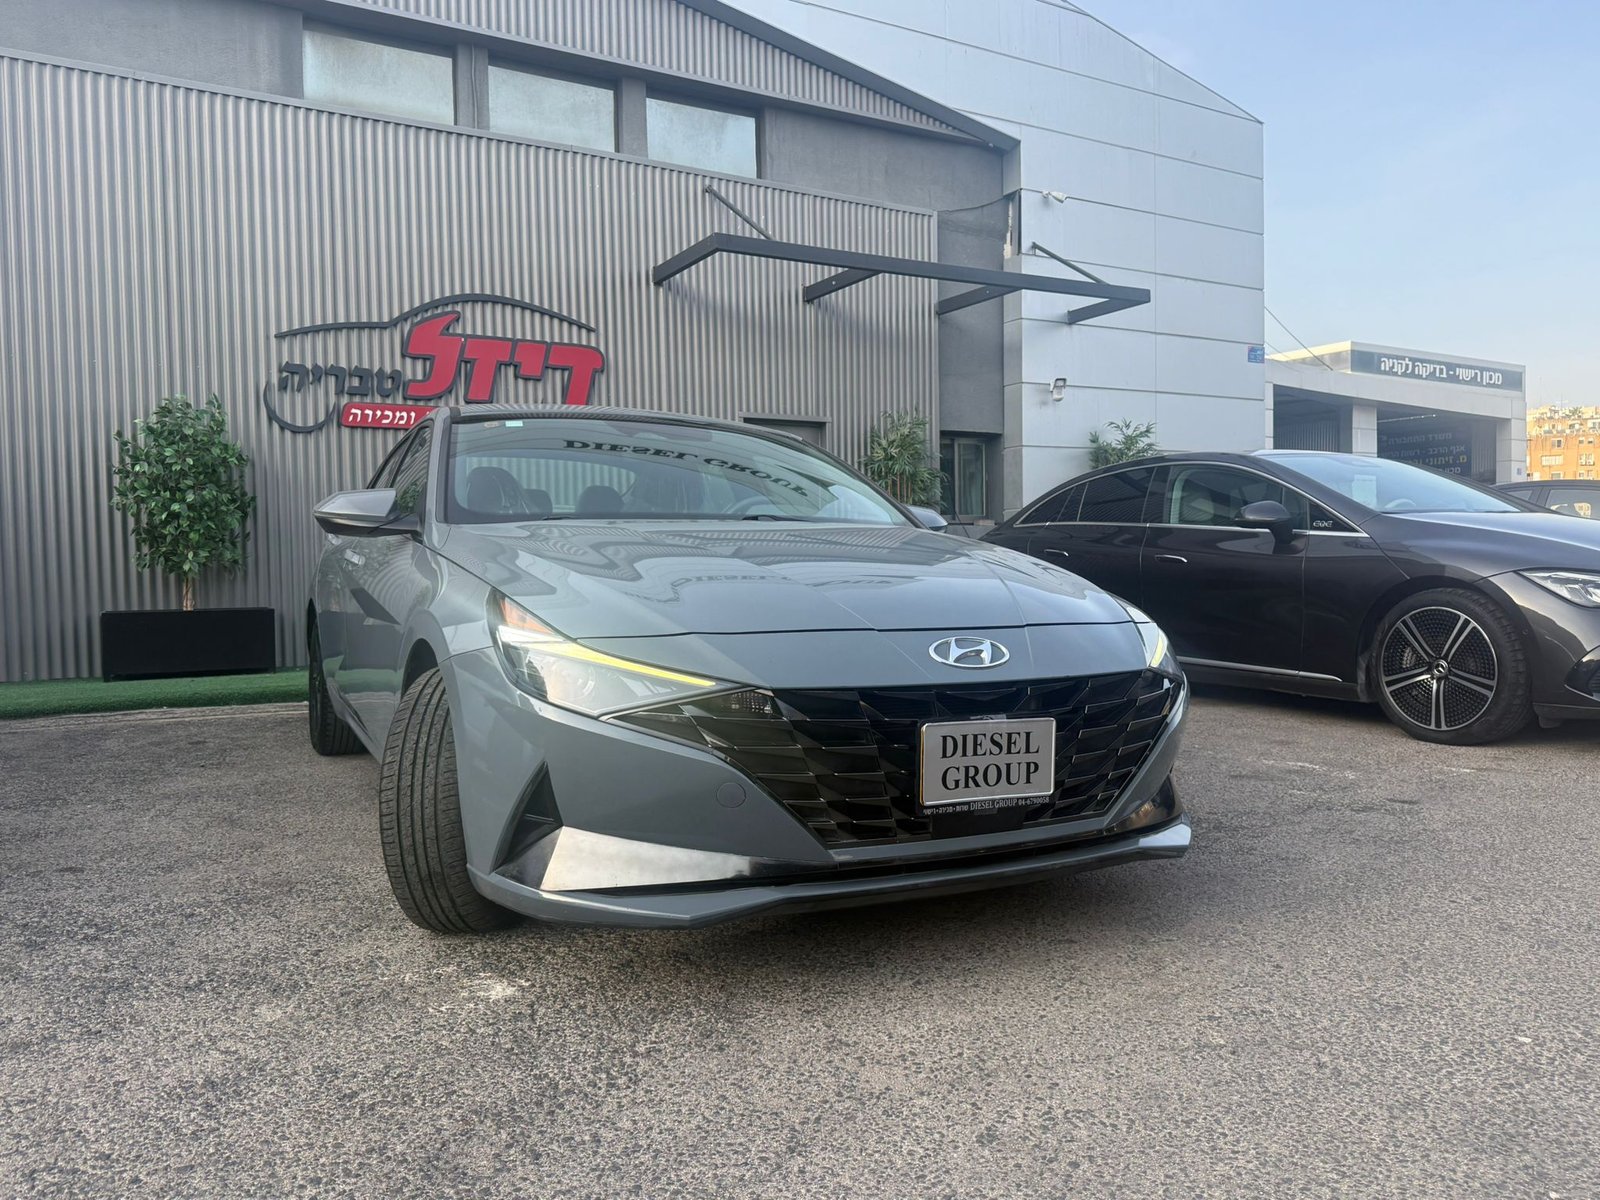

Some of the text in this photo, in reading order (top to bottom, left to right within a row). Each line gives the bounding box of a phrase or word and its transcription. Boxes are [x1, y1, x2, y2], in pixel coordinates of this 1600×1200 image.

[401, 310, 605, 405] דיזל
[1380, 357, 1413, 375] לקניה
[1415, 362, 1447, 378] בדיקה
[1456, 367, 1480, 382] רישוי
[1483, 370, 1502, 385] מכון
[278, 362, 403, 397] טבריה
[348, 407, 416, 425] ומכירה
[940, 731, 1040, 759] DIESEL
[941, 761, 1040, 791] GROUP
[970, 801, 994, 811] DIESEL
[994, 799, 1017, 808] GROUP
